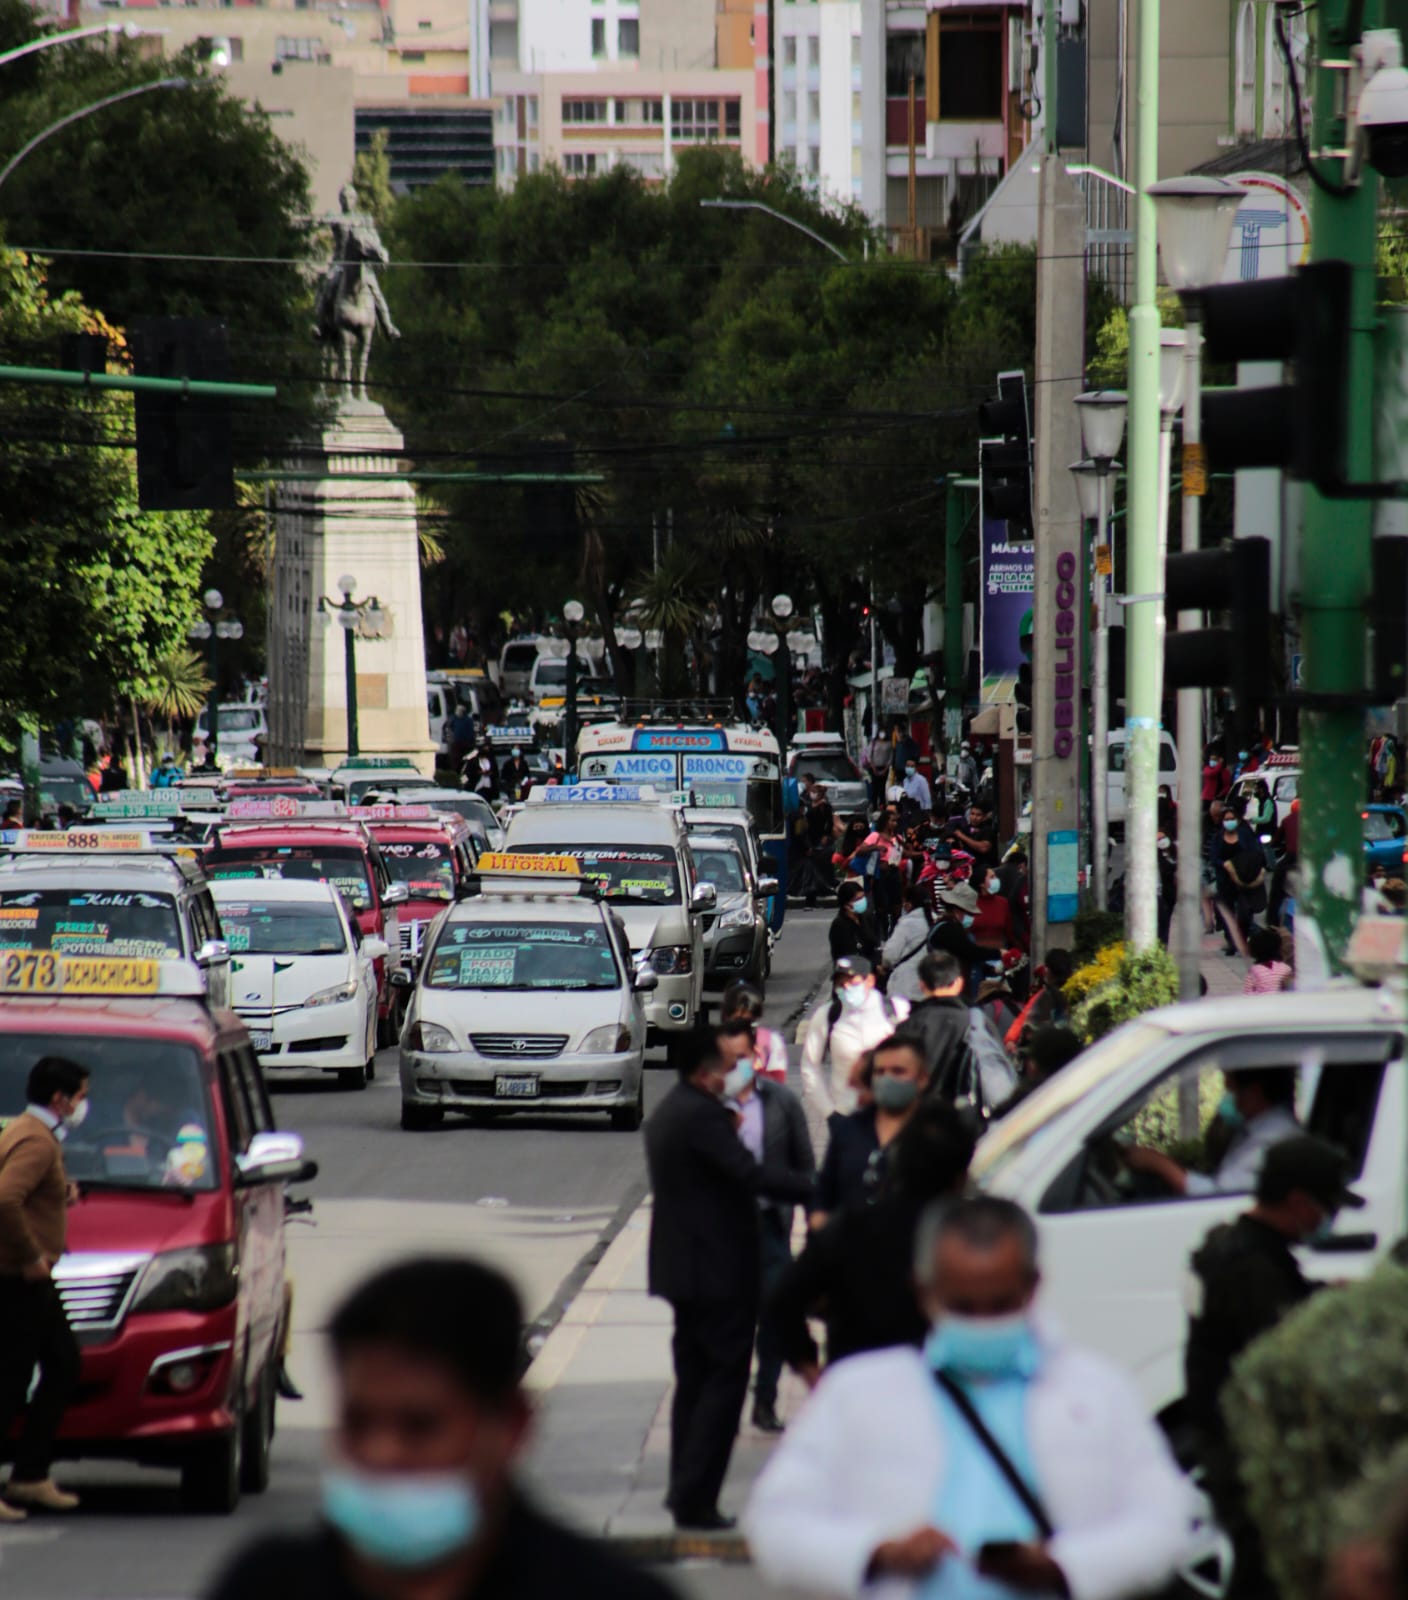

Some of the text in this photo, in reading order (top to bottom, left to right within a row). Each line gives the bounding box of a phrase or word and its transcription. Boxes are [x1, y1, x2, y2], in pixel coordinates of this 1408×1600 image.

[1055, 552, 1075, 758] OBELISCO
[651, 735, 711, 746] MICRO
[613, 759, 674, 775] AMIGO
[686, 759, 747, 774] BRONCO
[570, 787, 616, 800] 264
[67, 833, 99, 848] 888
[491, 855, 568, 872] LITORAL
[462, 949, 515, 959] PRADO
[6, 954, 55, 987] 273
[64, 962, 153, 985] ACHACHICALA
[461, 967, 513, 975] PRADO
